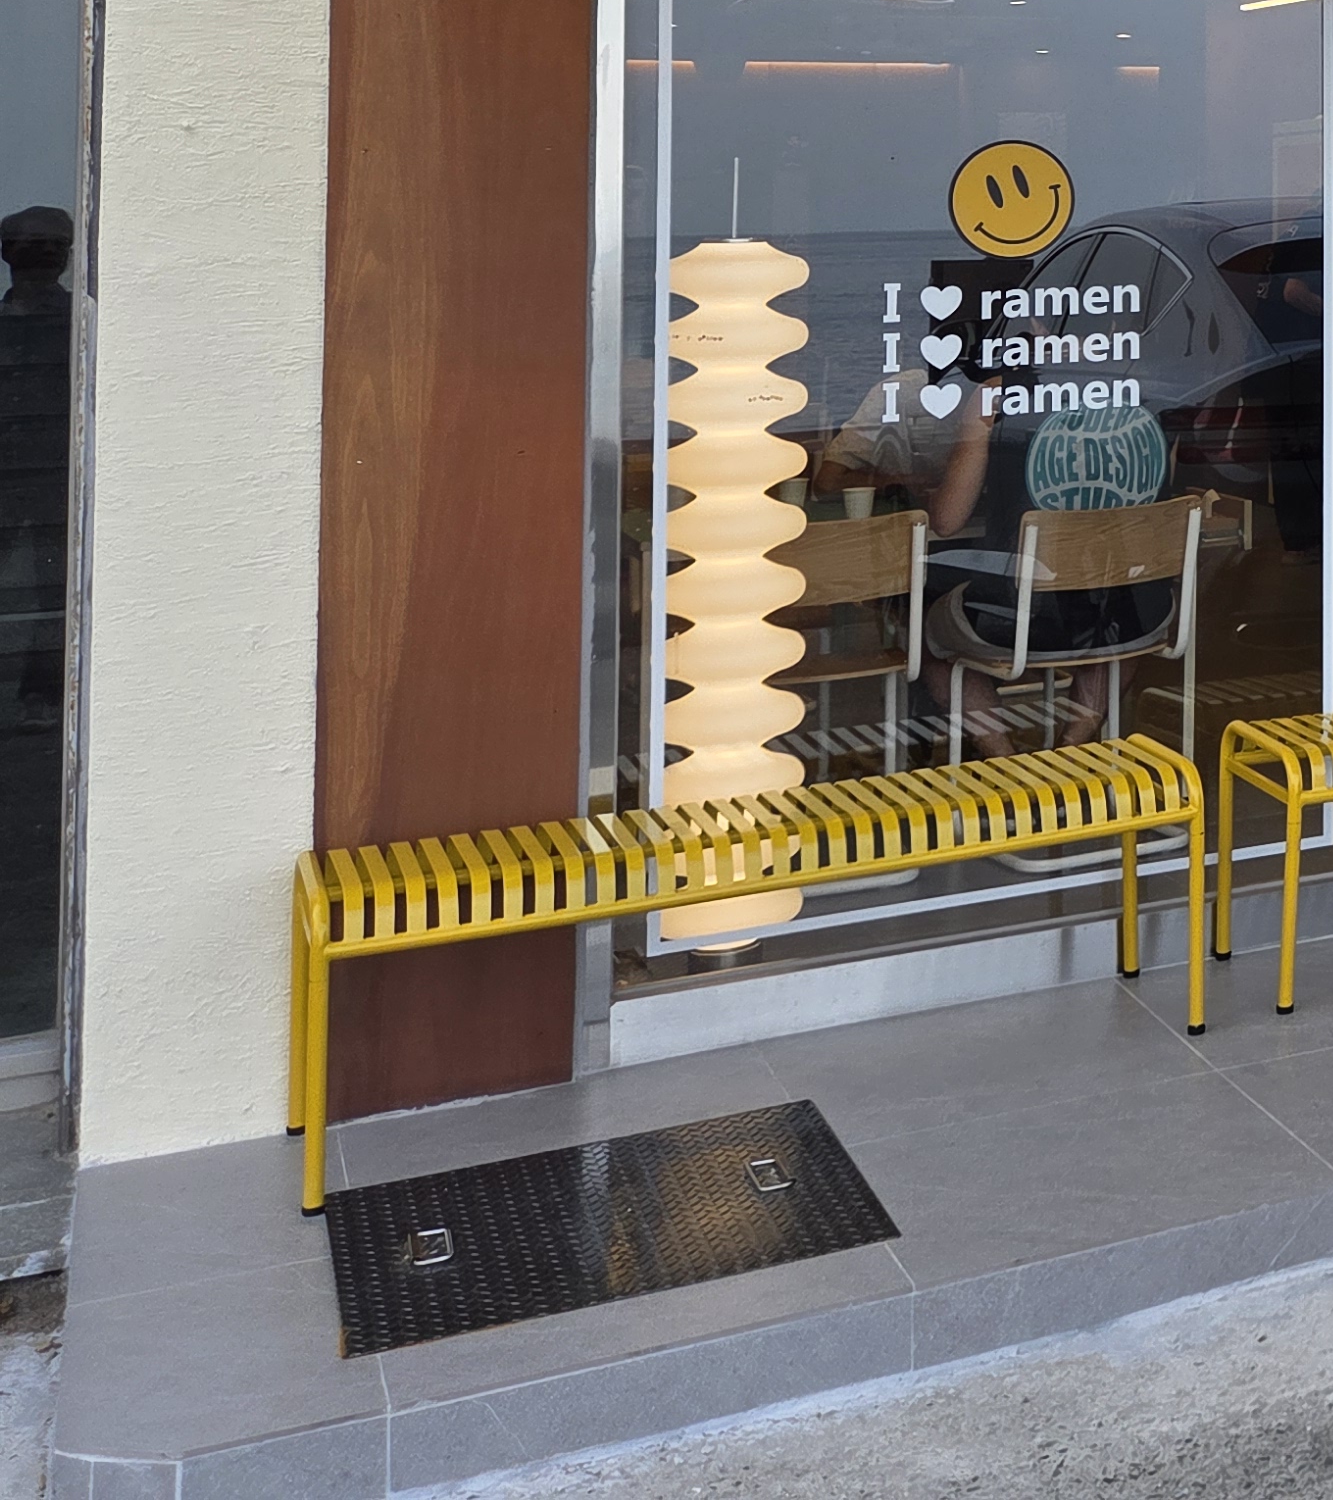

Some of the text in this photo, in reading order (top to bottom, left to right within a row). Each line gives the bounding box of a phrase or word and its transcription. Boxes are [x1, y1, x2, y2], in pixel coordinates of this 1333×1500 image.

[882, 283, 1140, 323] I ramen
[882, 330, 1140, 373] I ramen
[881, 377, 1140, 423] I ramen
[1033, 420, 1164, 494] AGE DESIGN
